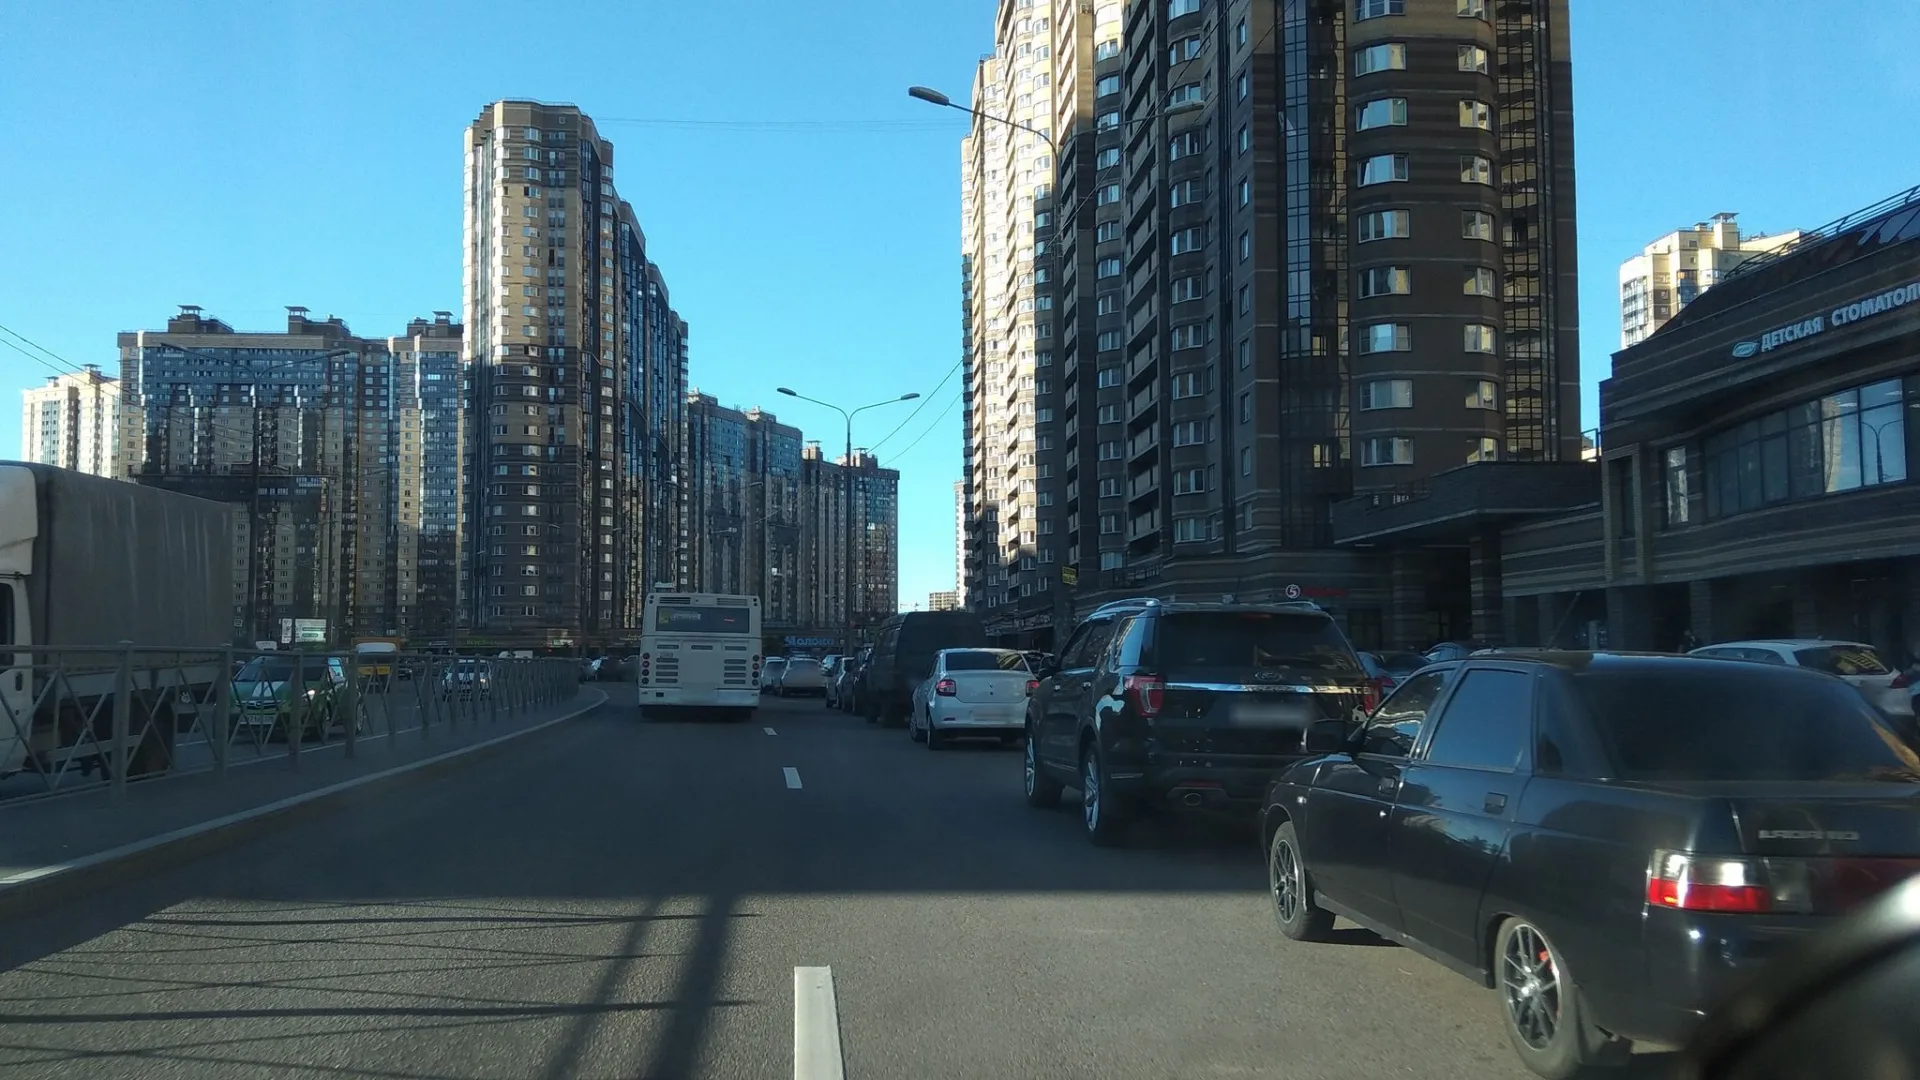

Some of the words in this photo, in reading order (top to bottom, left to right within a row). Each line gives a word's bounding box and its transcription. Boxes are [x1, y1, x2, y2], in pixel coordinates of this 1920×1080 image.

[1761, 317, 1824, 352] ДЕТСКАЯ
[1832, 283, 1920, 326] СТОМАТОЛ
[1288, 585, 1299, 598] 5
